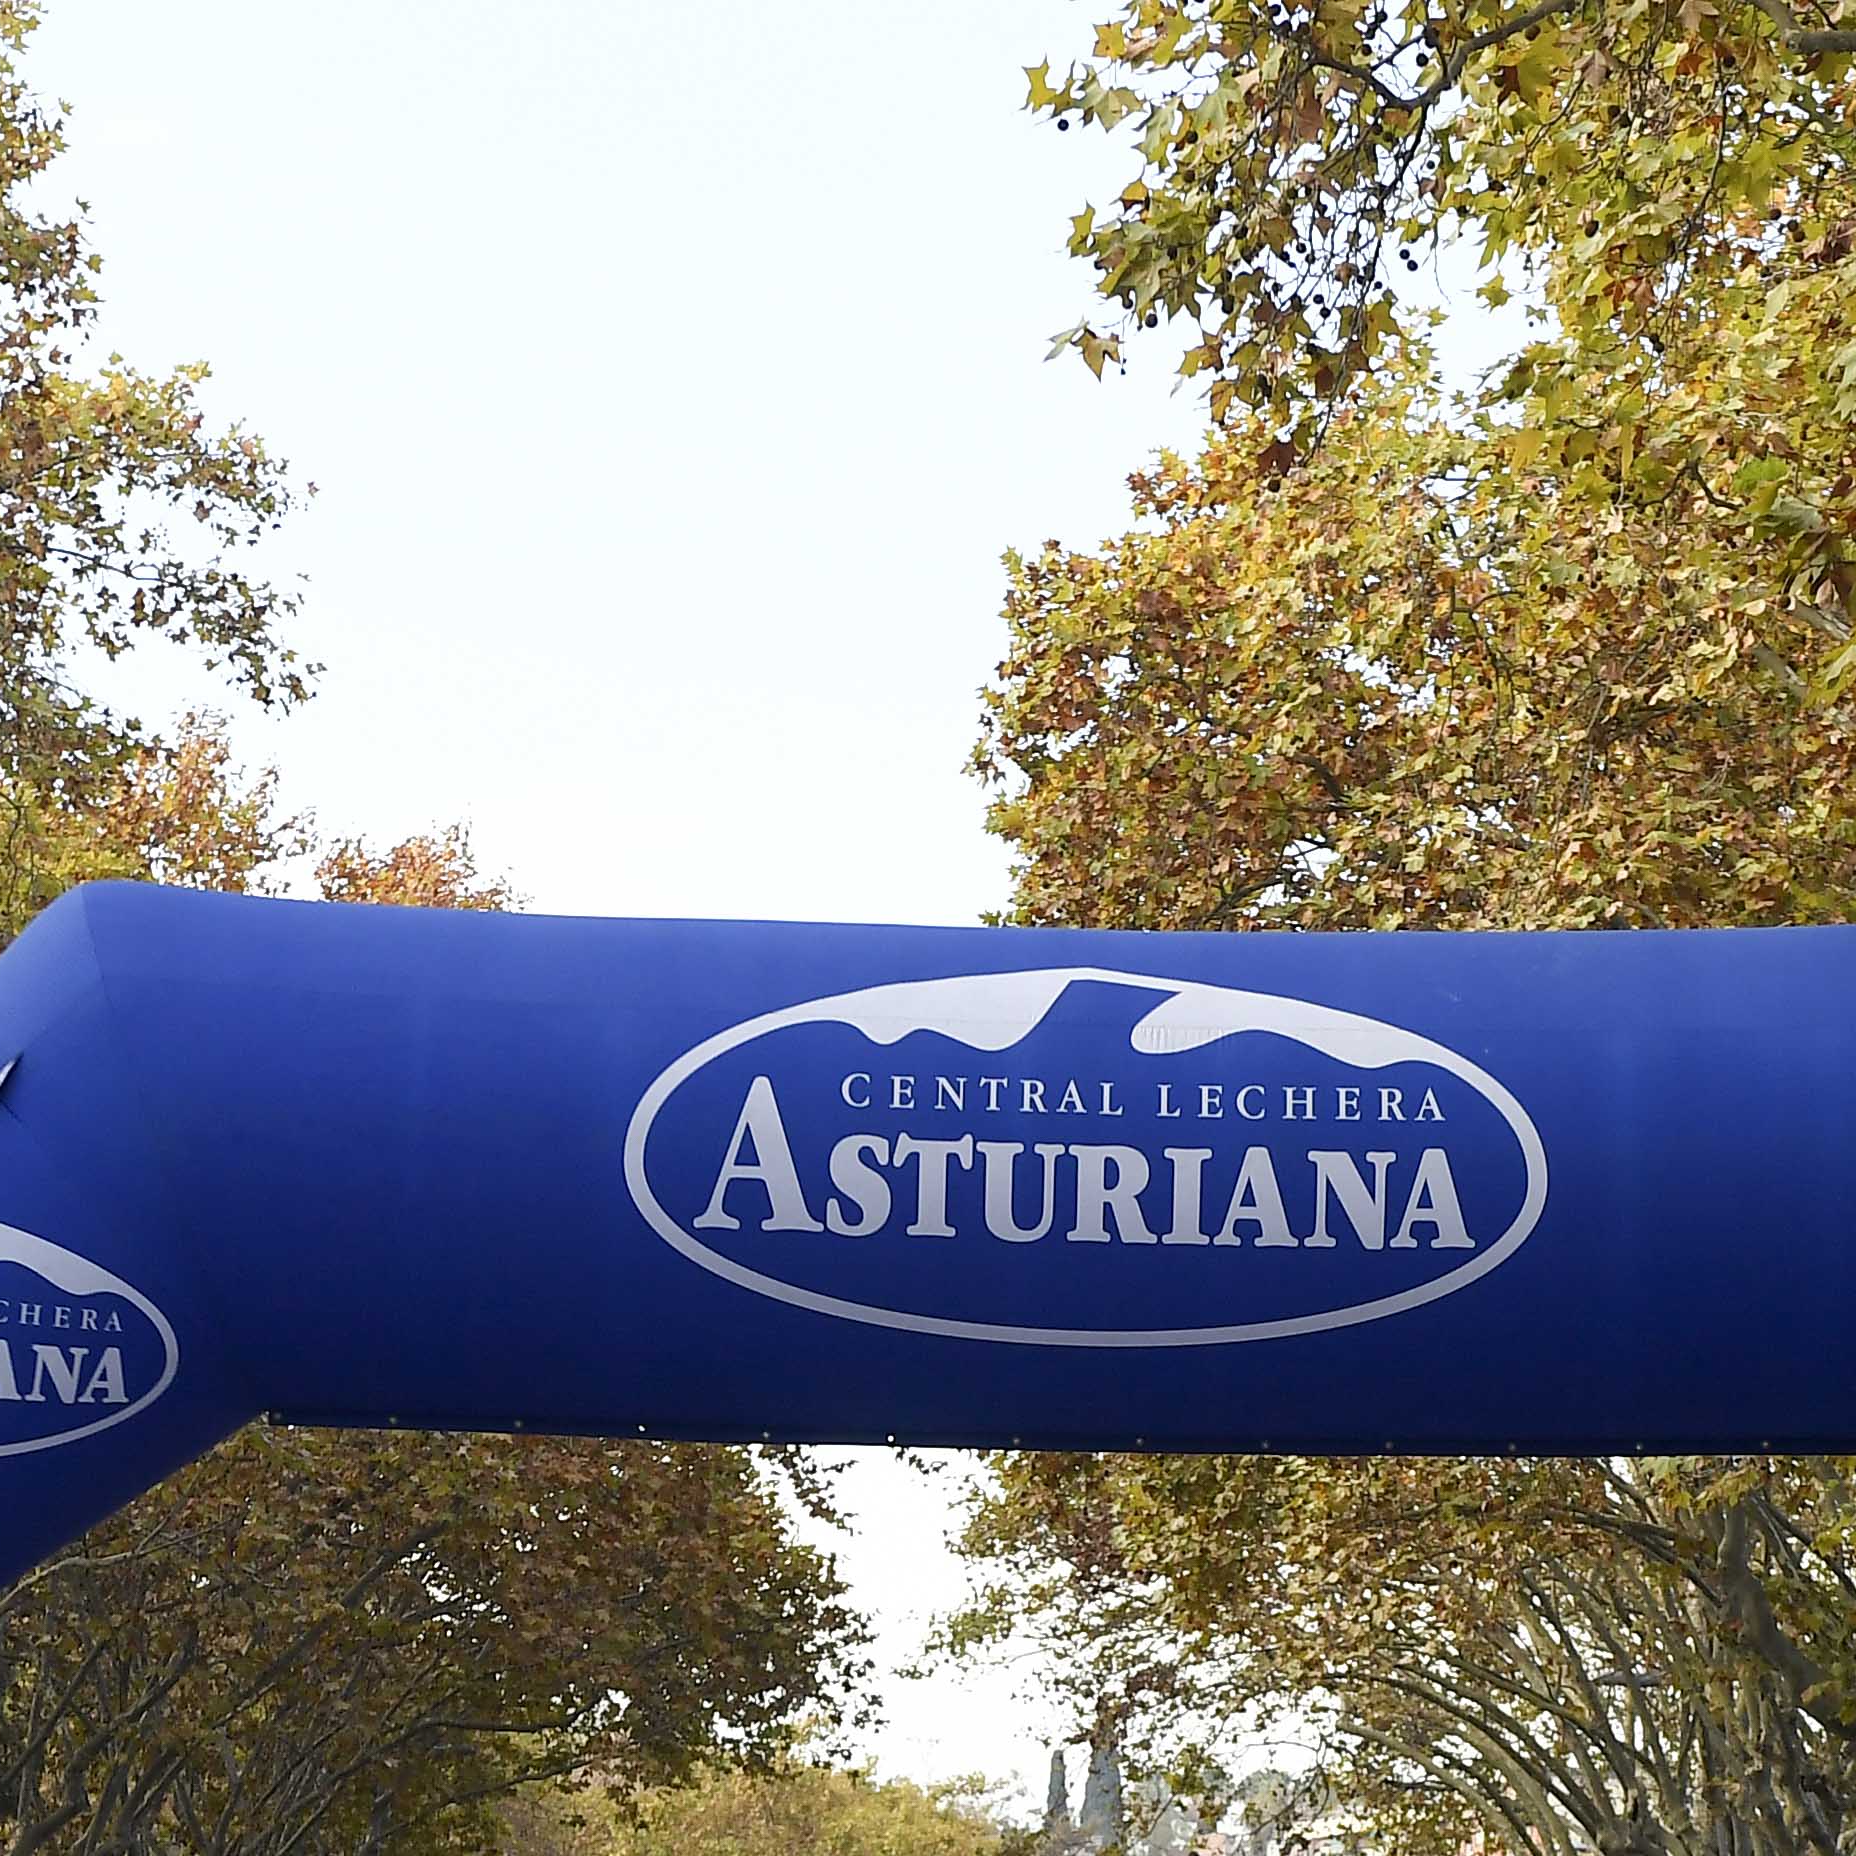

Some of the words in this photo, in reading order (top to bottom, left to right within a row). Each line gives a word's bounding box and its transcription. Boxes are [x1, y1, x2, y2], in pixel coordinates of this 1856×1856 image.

[840, 1072, 1125, 1117] CENTRAL
[1157, 1083, 1447, 1122] LECHERA
[693, 1075, 1477, 1252] ASTURIANA
